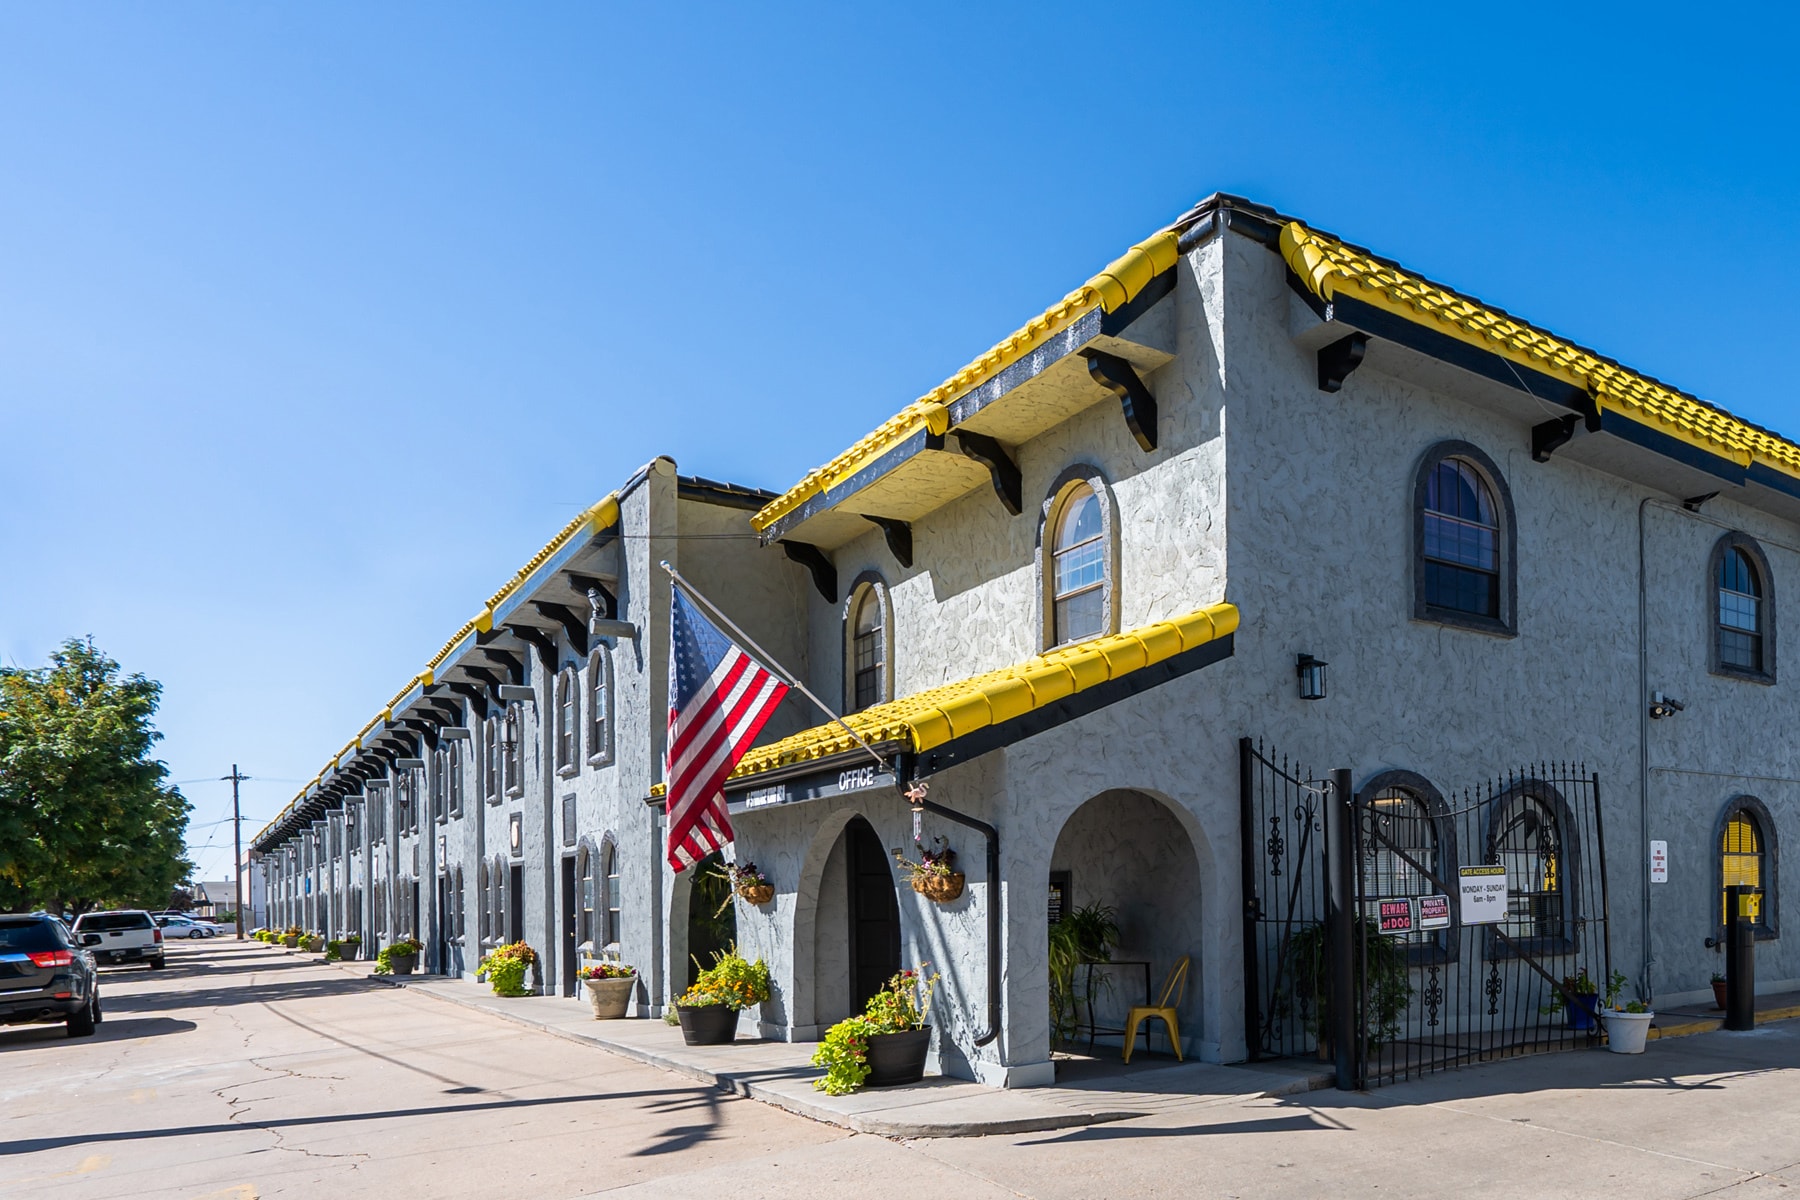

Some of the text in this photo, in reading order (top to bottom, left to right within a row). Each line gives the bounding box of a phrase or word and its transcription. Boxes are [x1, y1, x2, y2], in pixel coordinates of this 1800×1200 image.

[838, 766, 874, 791] OFFICE
[1461, 866, 1505, 876] GATE ACCESS HOURS
[1462, 885, 1483, 894] MONDAY
[1486, 884, 1505, 893] SUNDAY
[1423, 899, 1445, 908] PRIVATE
[1382, 903, 1408, 915] BEWARE
[1421, 906, 1447, 915] PROPERTY
[1382, 917, 1410, 929] of DOG
